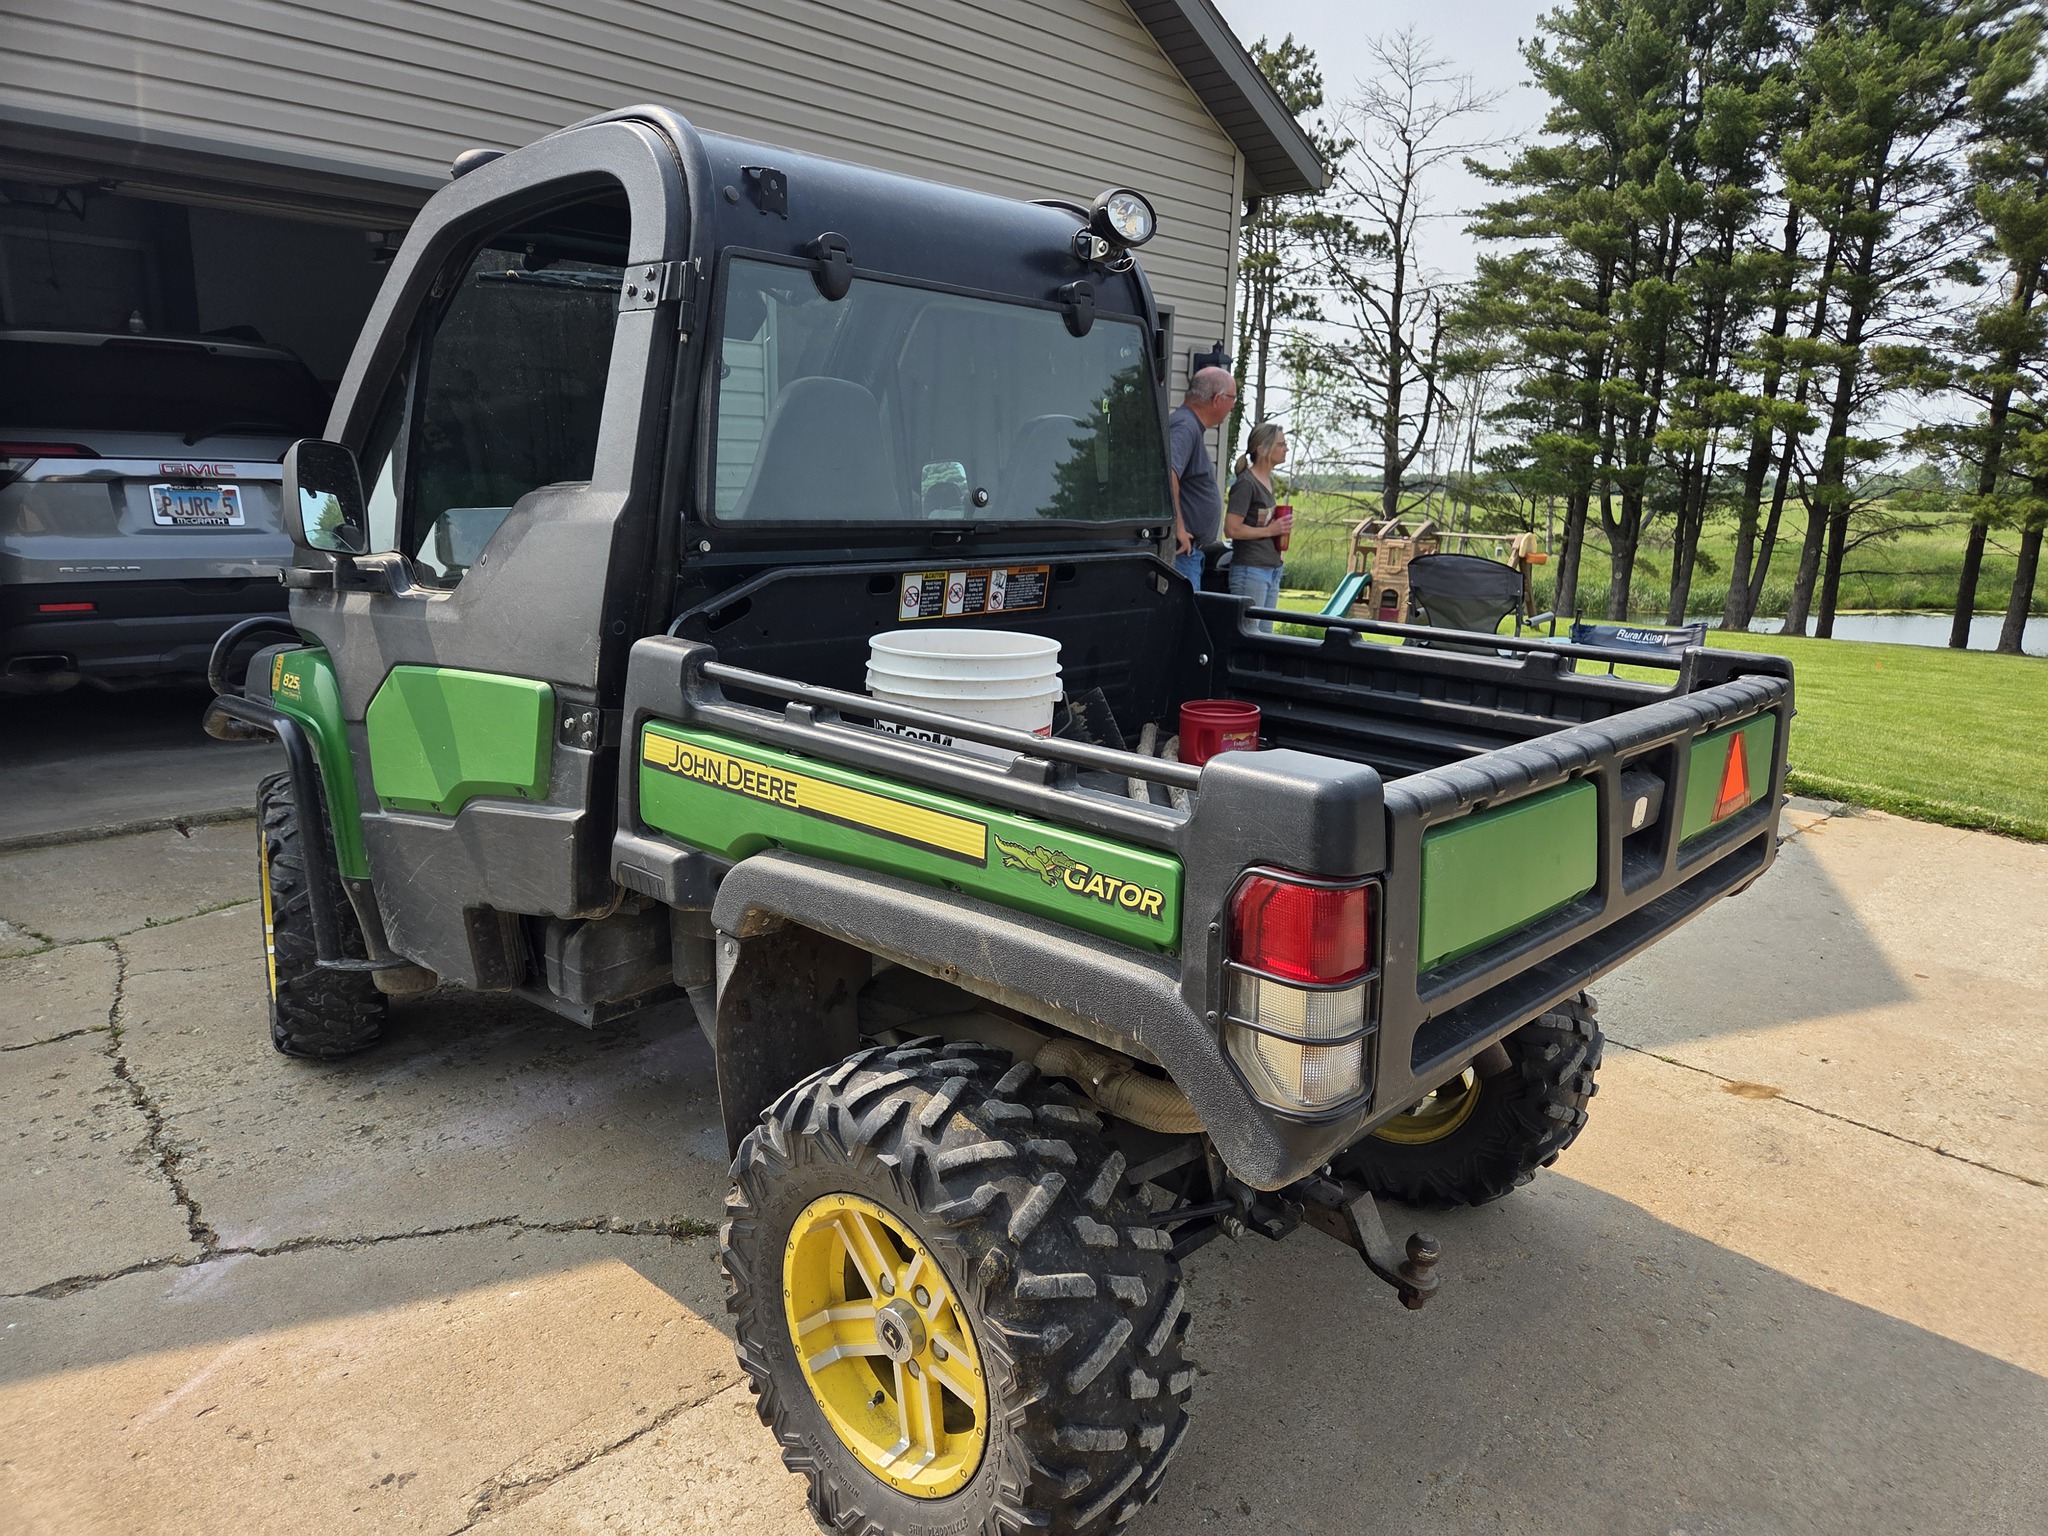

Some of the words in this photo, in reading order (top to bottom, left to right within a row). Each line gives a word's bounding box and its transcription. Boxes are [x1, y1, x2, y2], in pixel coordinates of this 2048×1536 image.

[160, 463, 236, 477] GMC
[1617, 628, 1643, 640] Rural
[1643, 632, 1663, 643] King
[668, 745, 722, 782] JOHN
[727, 760, 798, 804] DEERE
[1063, 863, 1165, 919] GATOR
[808, 1432, 833, 1469] RADIAL
[839, 1474, 860, 1498] NYLON
